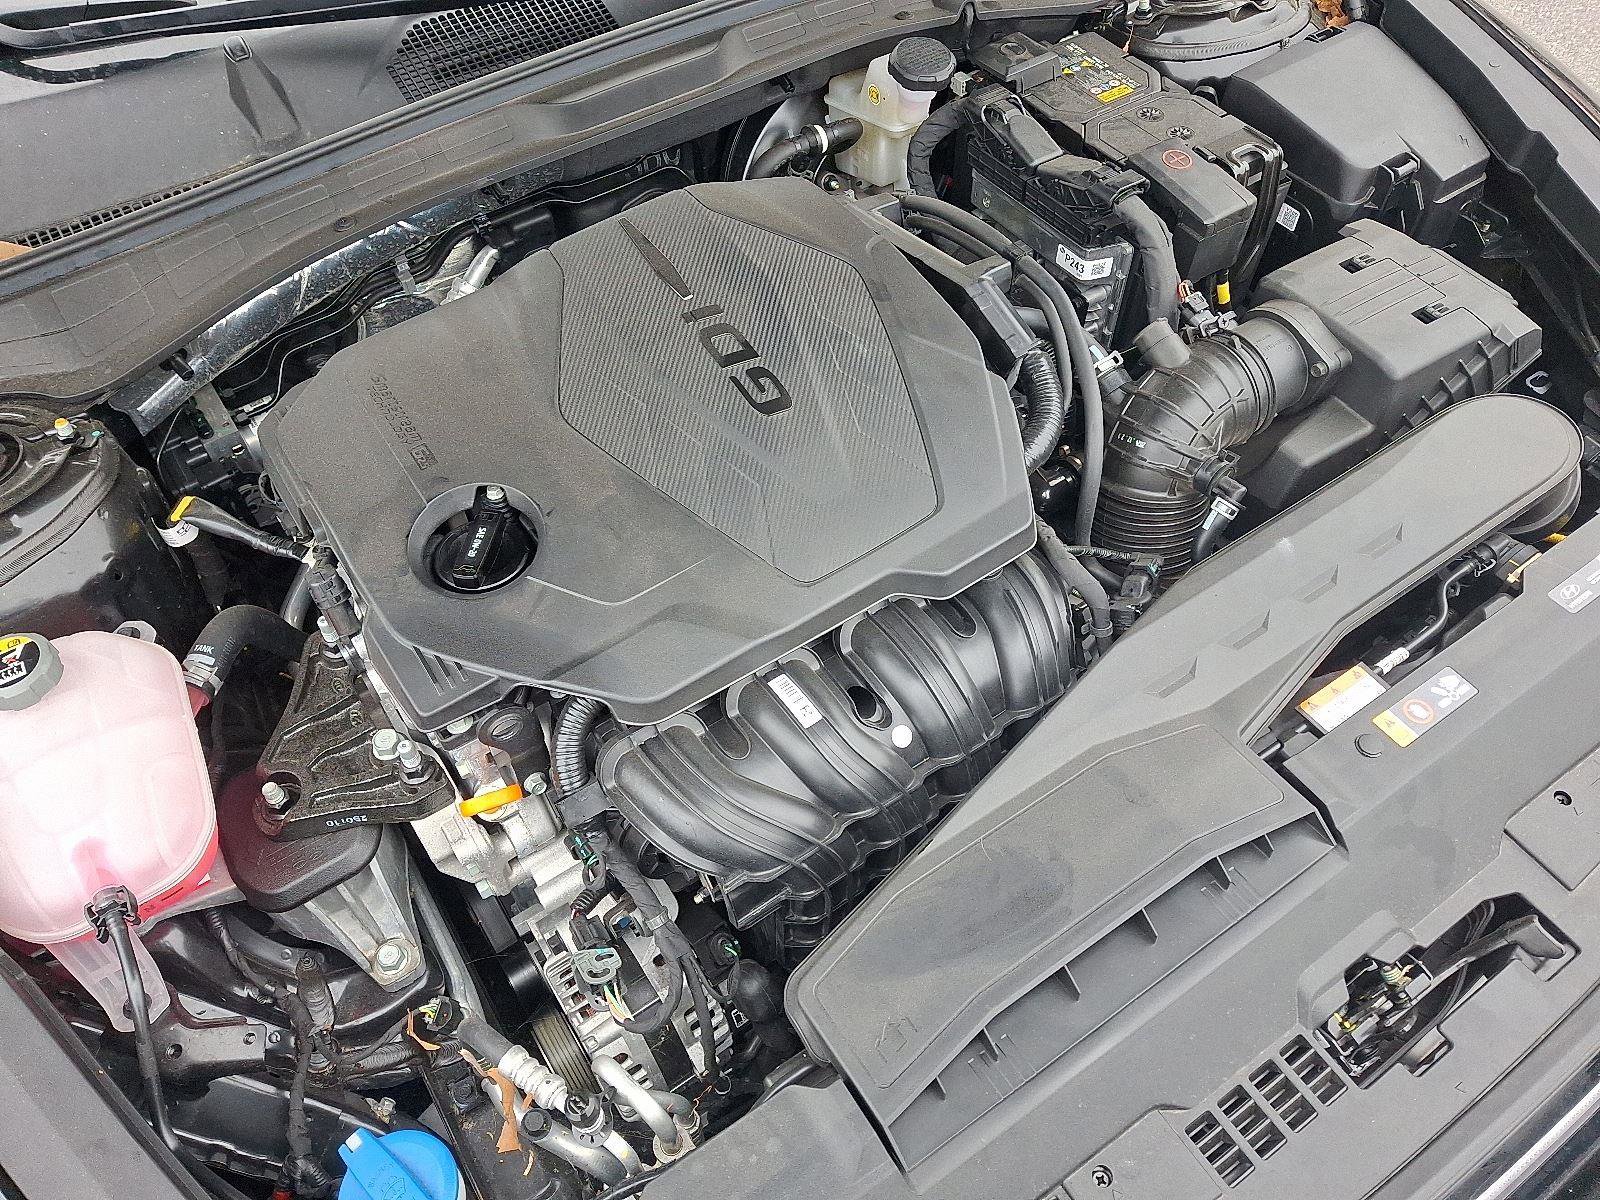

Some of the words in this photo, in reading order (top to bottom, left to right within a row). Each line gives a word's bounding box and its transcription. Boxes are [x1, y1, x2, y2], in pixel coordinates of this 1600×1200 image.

[1065, 253, 1085, 274] P243
[477, 527, 487, 542] SAE
[193, 644, 215, 655] TANK
